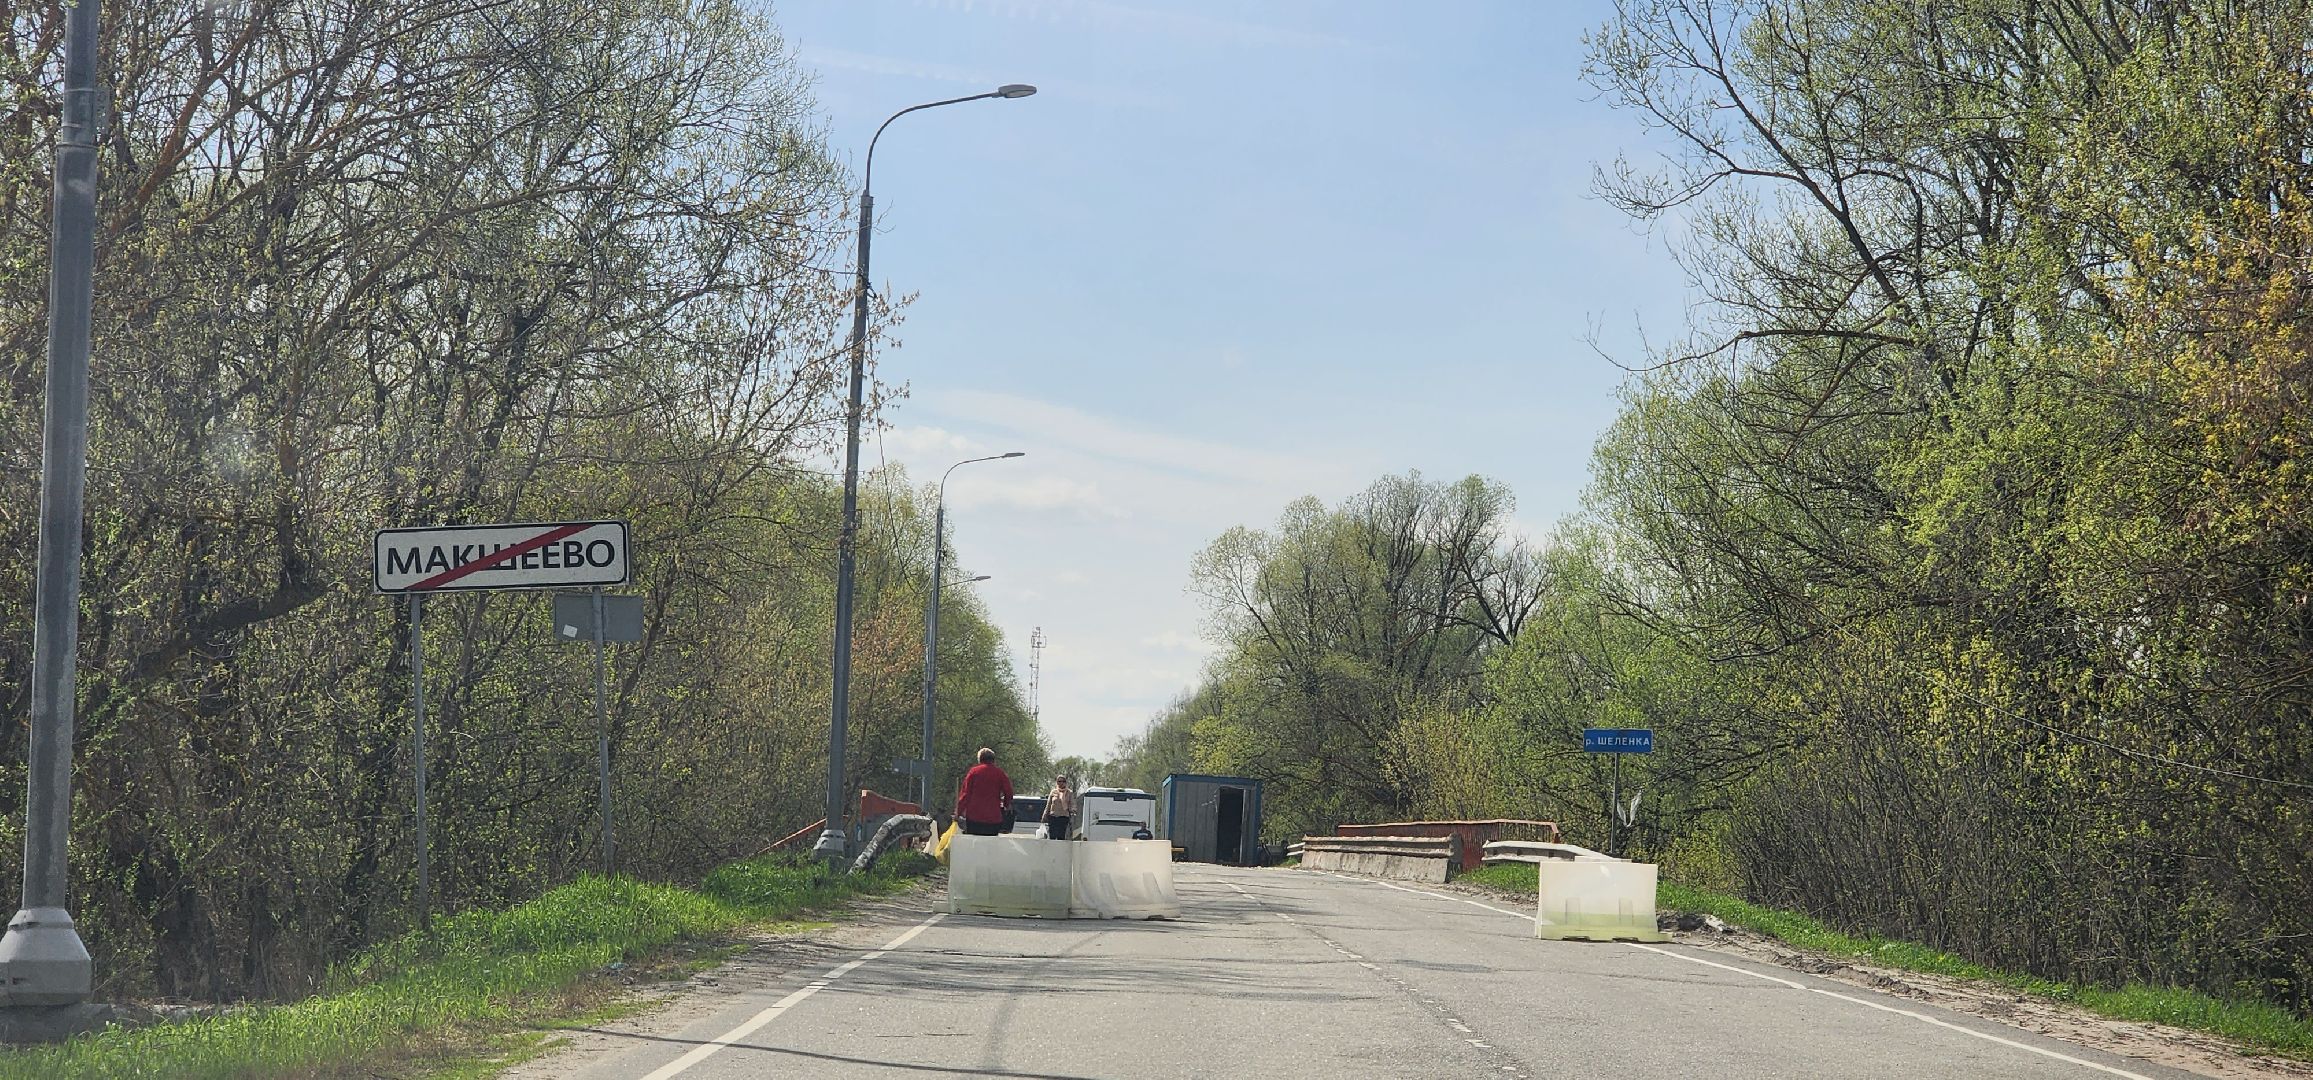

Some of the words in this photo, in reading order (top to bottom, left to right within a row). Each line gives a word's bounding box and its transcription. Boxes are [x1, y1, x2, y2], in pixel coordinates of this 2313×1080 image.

[386, 539, 615, 575] МАКШЕЕВО
[1585, 738, 1595, 747] р.
[1597, 736, 1650, 746] ШЕЛЕНКА
